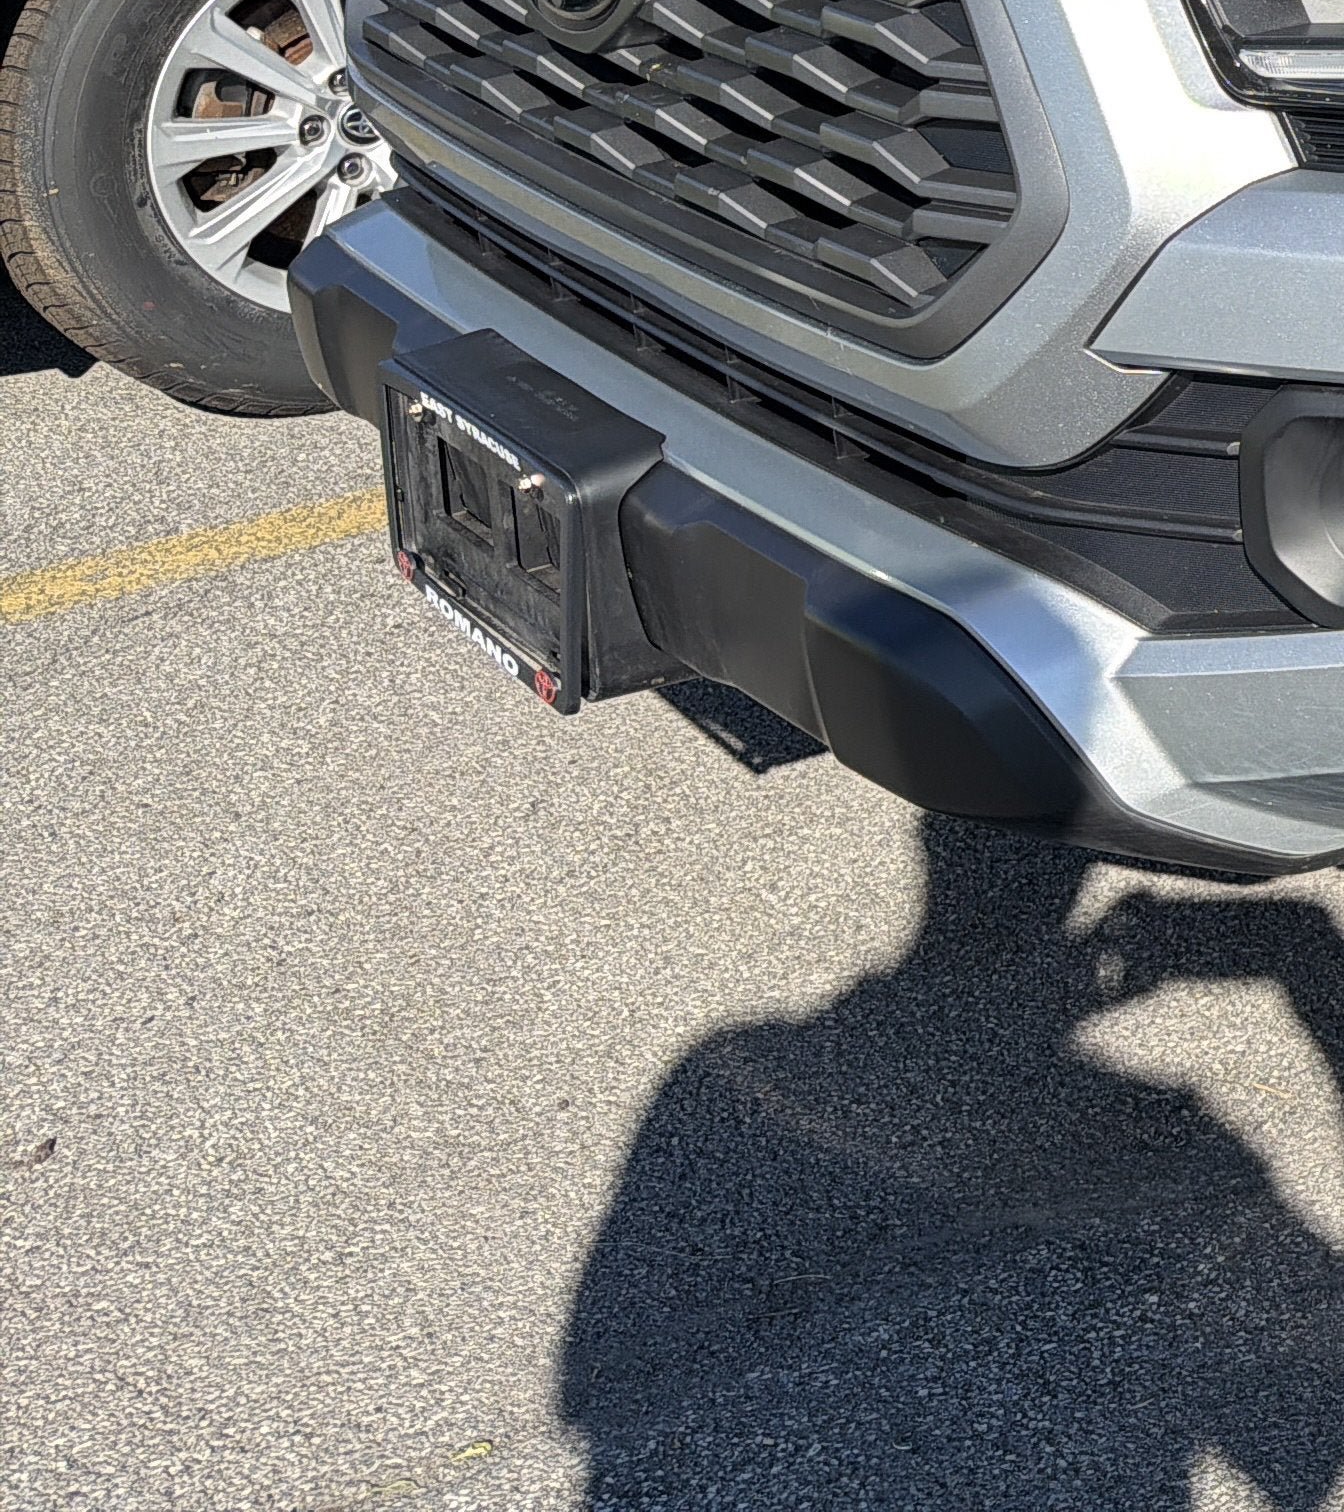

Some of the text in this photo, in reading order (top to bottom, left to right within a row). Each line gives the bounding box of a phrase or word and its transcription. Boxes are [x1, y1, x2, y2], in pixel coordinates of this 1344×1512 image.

[420, 391, 522, 472] EAST SYRACUSE
[425, 583, 519, 677] ROMANO
